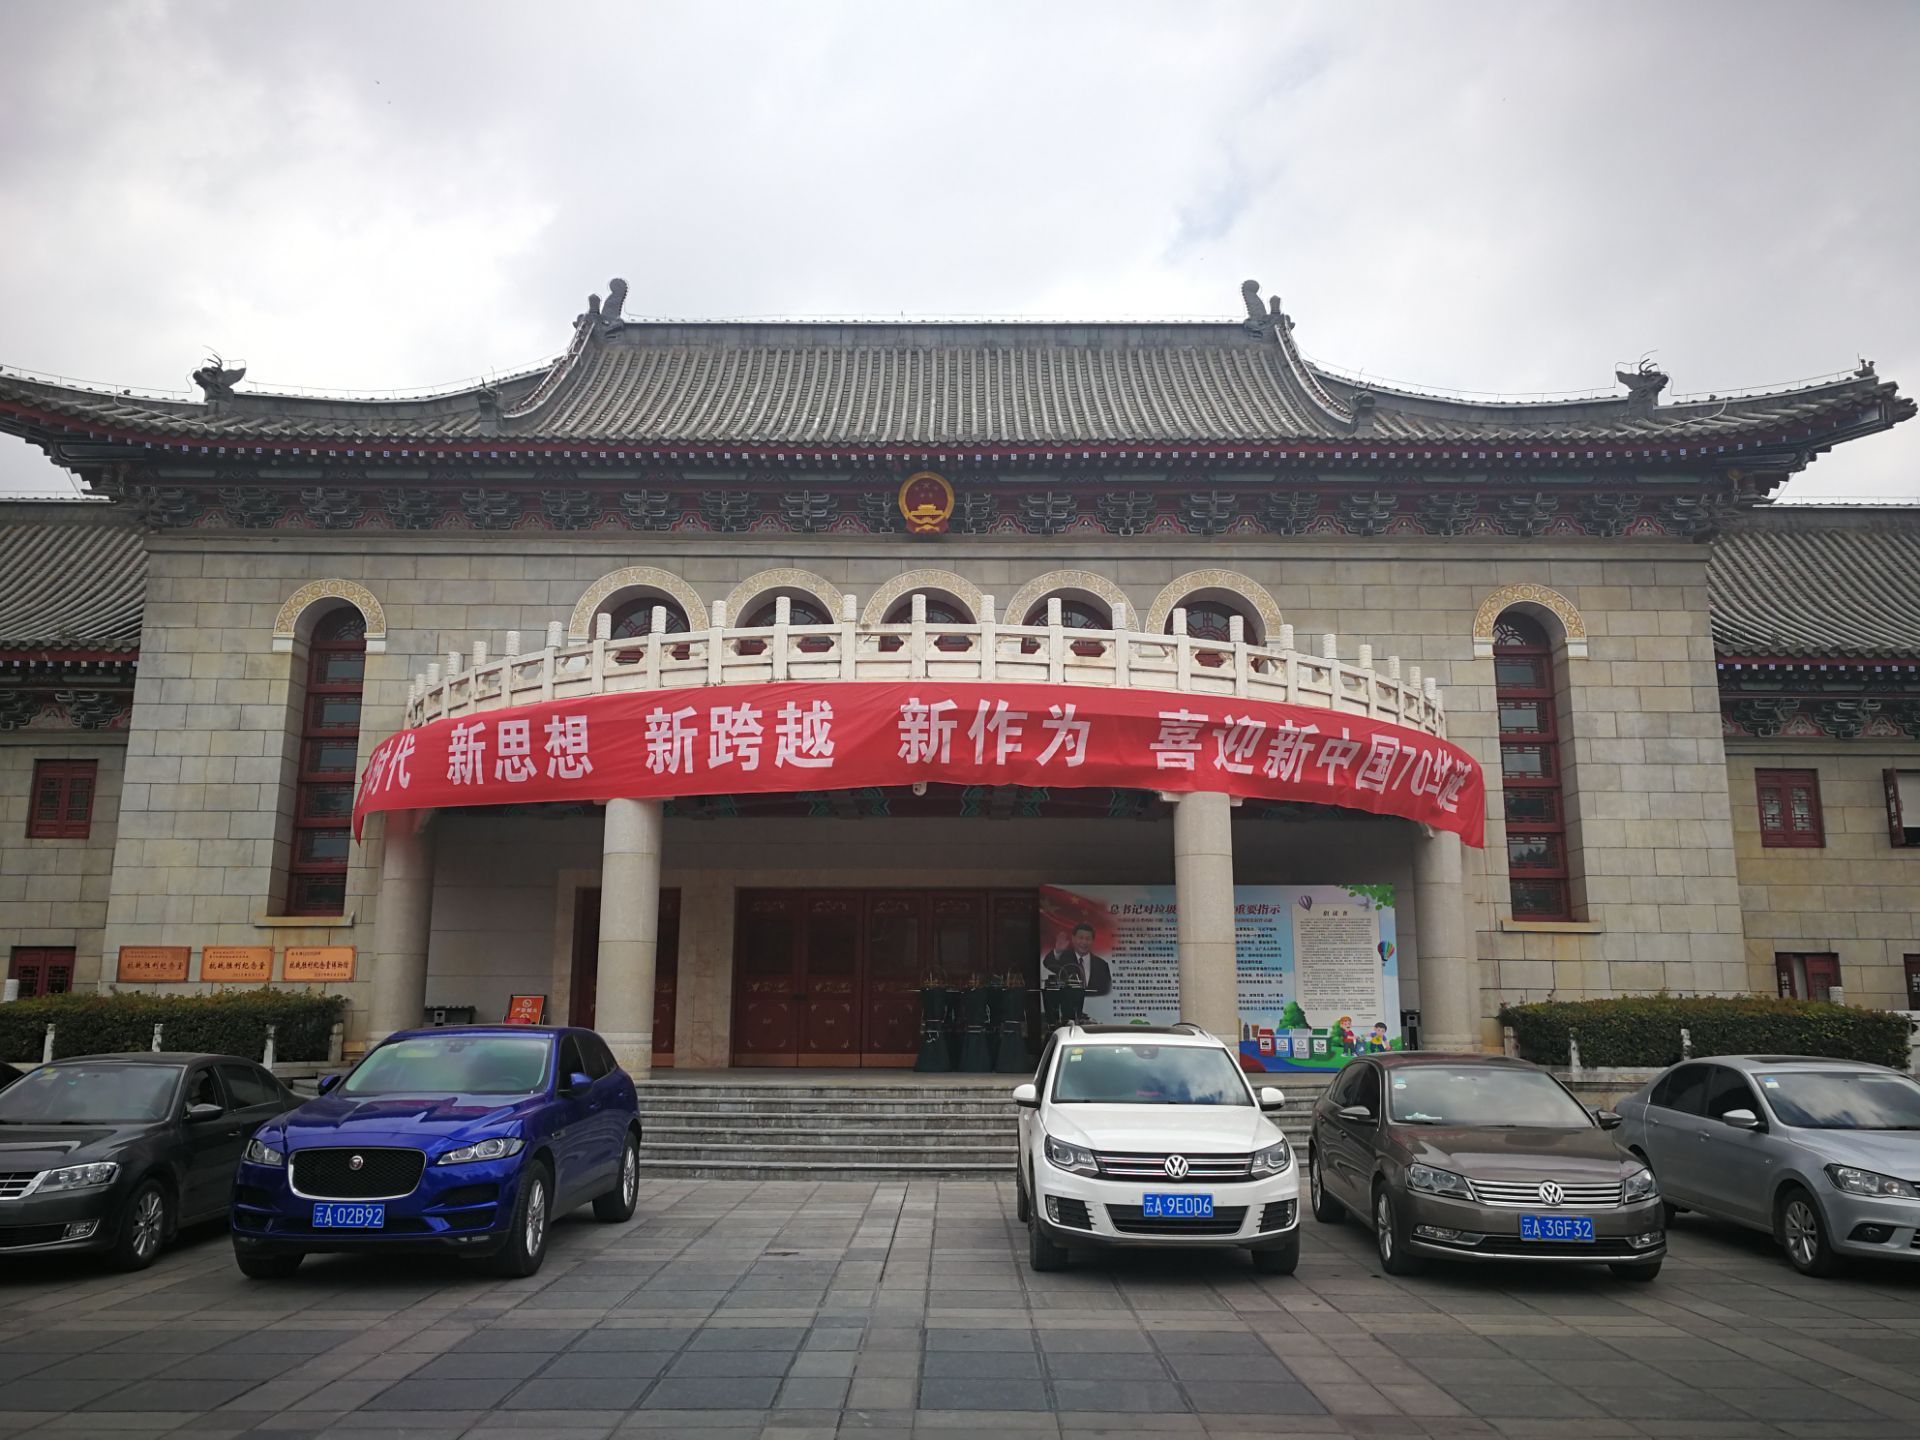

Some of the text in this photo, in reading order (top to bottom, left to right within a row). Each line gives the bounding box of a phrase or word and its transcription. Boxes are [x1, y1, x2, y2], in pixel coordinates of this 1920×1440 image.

[446, 714, 594, 786] 新思想
[645, 700, 835, 775] 新跨越
[897, 697, 1091, 767] 新作为
